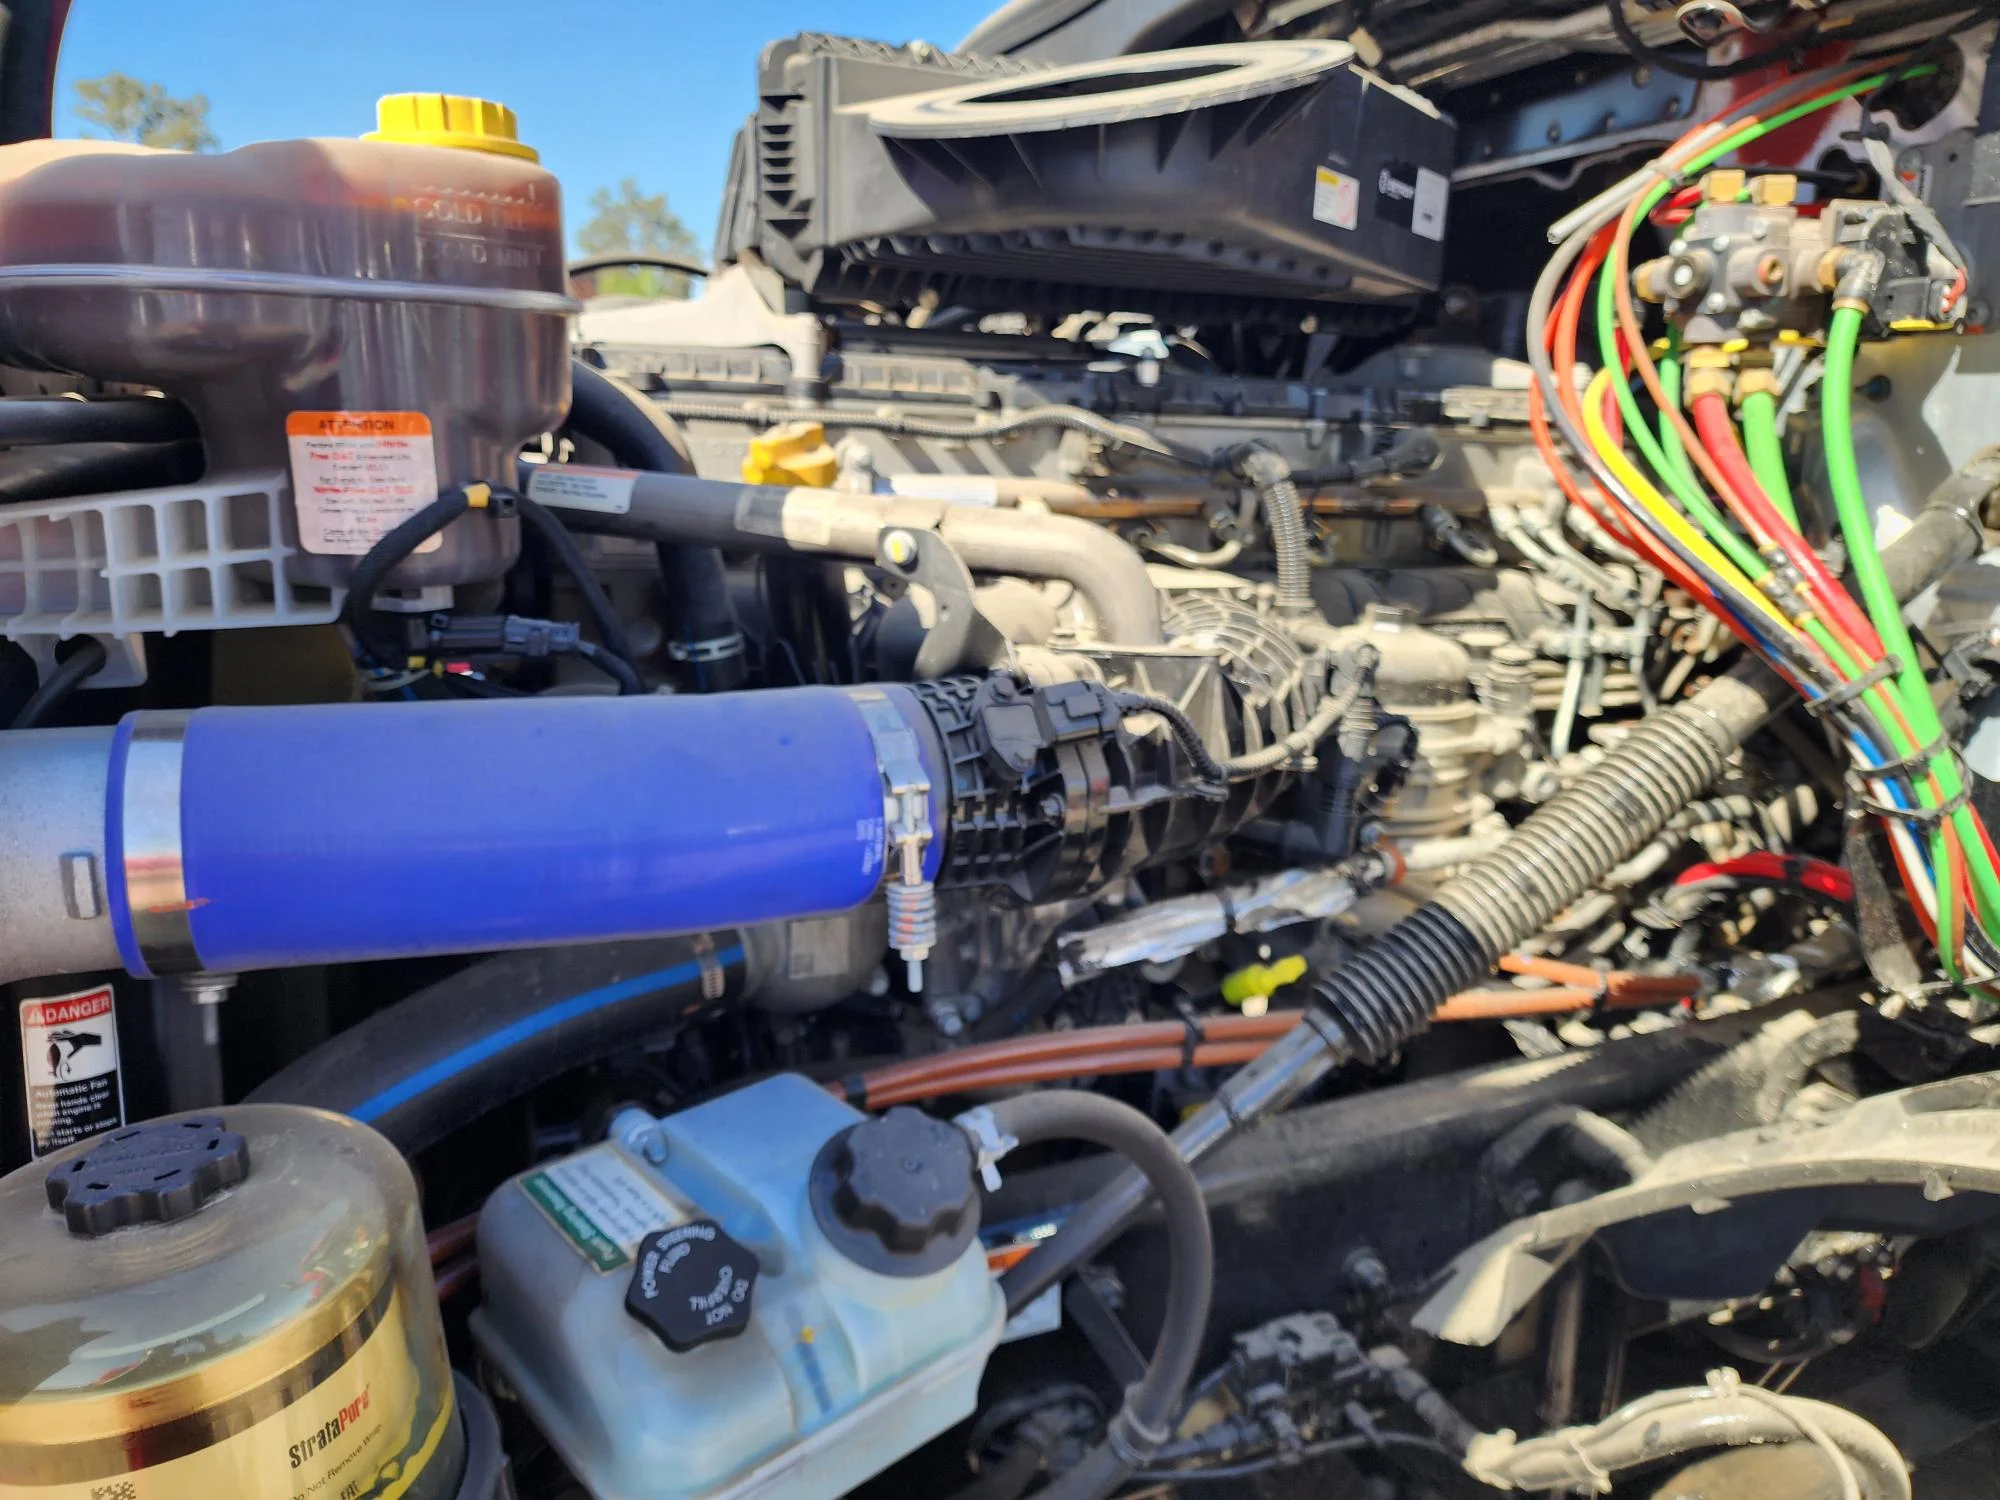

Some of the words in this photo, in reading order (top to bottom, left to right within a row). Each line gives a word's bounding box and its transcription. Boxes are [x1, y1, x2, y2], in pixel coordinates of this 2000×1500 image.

[45, 995, 111, 1023] DANGER
[35, 1084, 88, 1098] Automatic
[90, 1078, 108, 1090] Fan
[62, 1104, 92, 1118] engine
[655, 1224, 716, 1251] STEERING
[688, 1265, 733, 1312] OVERFILL
[731, 1278, 749, 1303] DO
[705, 1302, 734, 1326] NOT
[288, 1390, 369, 1470] StrataPore
[306, 1477, 326, 1496] Not
[327, 1444, 363, 1480] Remove
